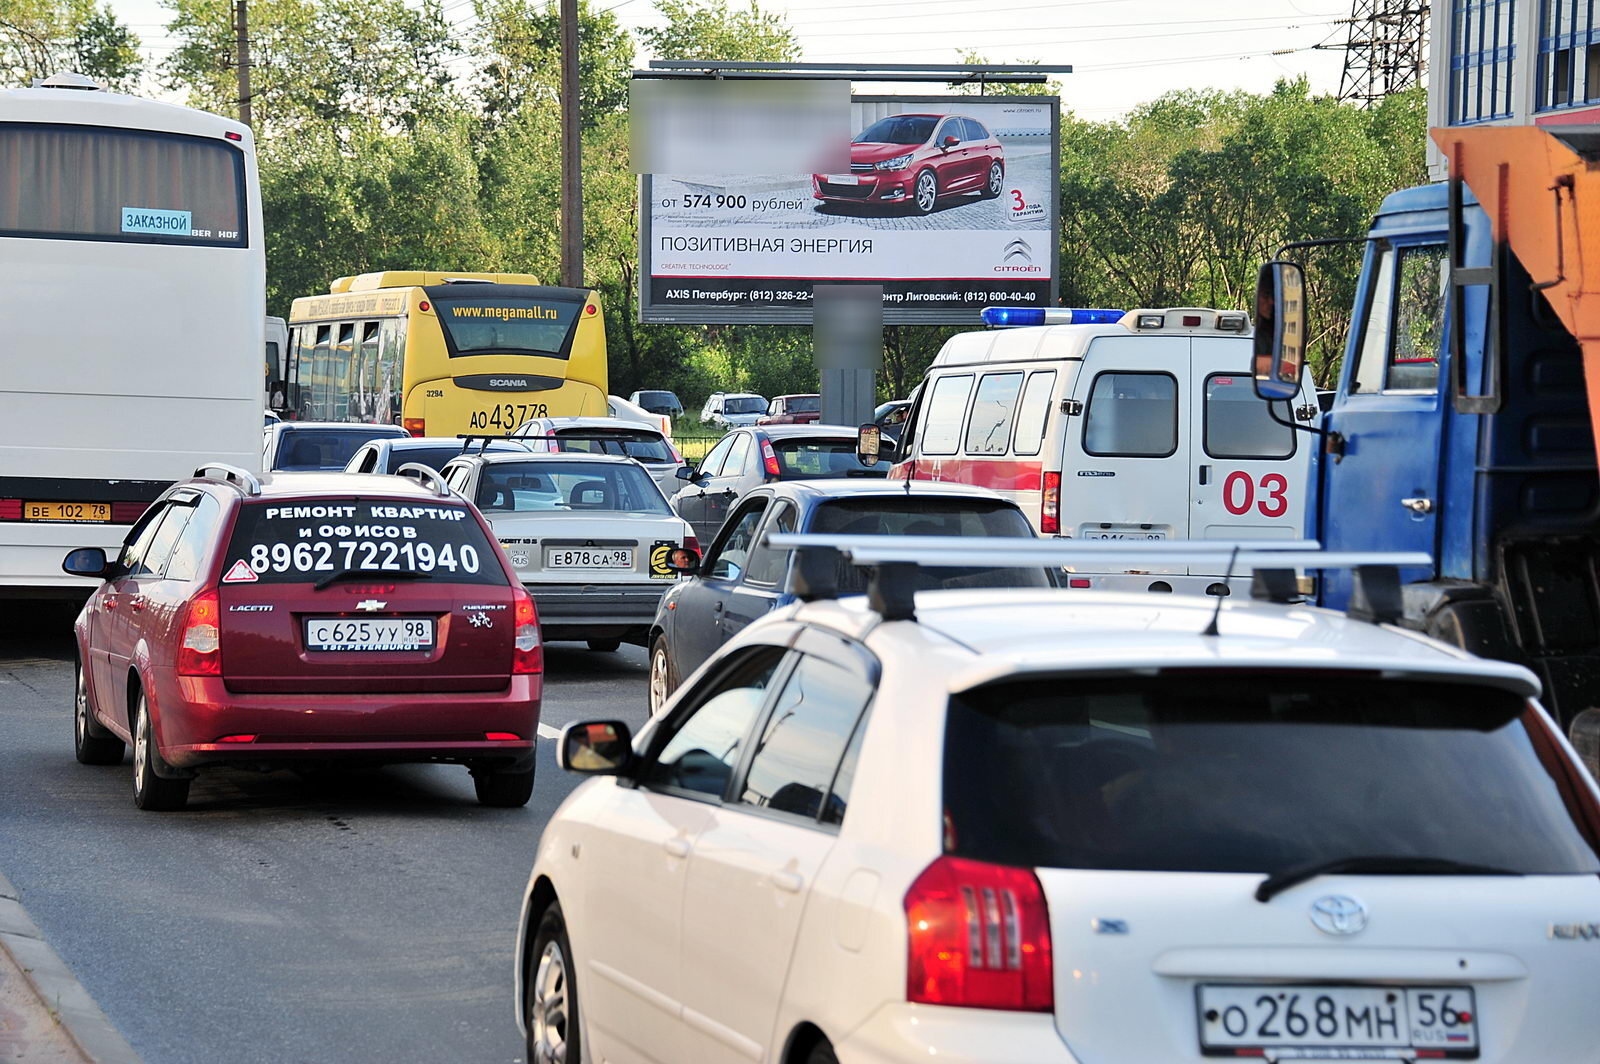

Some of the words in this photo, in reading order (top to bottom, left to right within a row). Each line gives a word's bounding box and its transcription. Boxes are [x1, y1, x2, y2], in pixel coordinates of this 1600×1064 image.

[661, 198, 678, 208] от
[683, 194, 712, 209] 574
[716, 195, 747, 209] 900
[1010, 189, 1025, 211] 3
[1012, 209, 1044, 218] ГАРАНТИИ
[126, 214, 187, 231] ЗАКАЗНОЙ
[218, 231, 239, 239] HOF
[660, 236, 785, 253] ПОЗИТИВНАЯ
[790, 238, 873, 254] ЭНЕРГИЯ
[993, 264, 1042, 272] CITROËN
[665, 289, 690, 299] AXIS
[692, 289, 748, 302] Петербург:
[749, 290, 774, 302] (812)
[905, 291, 962, 302] Лиговский:
[963, 291, 988, 303] (812)
[989, 292, 1037, 302] 600-40-40
[452, 305, 558, 322] www.megamall.ru
[489, 378, 528, 388] SCANIA
[426, 389, 444, 398] 3294
[1222, 470, 1289, 518] 03
[91, 504, 106, 515] 78
[265, 506, 357, 520] РЕМОНТ
[370, 506, 466, 521] КВАРТИР
[318, 524, 418, 539] ОФИСОВ
[512, 557, 528, 565] RUS
[613, 551, 627, 562] 98
[404, 622, 425, 637] 98
[1417, 993, 1460, 1028] 56
[1412, 1030, 1446, 1042] RUS
